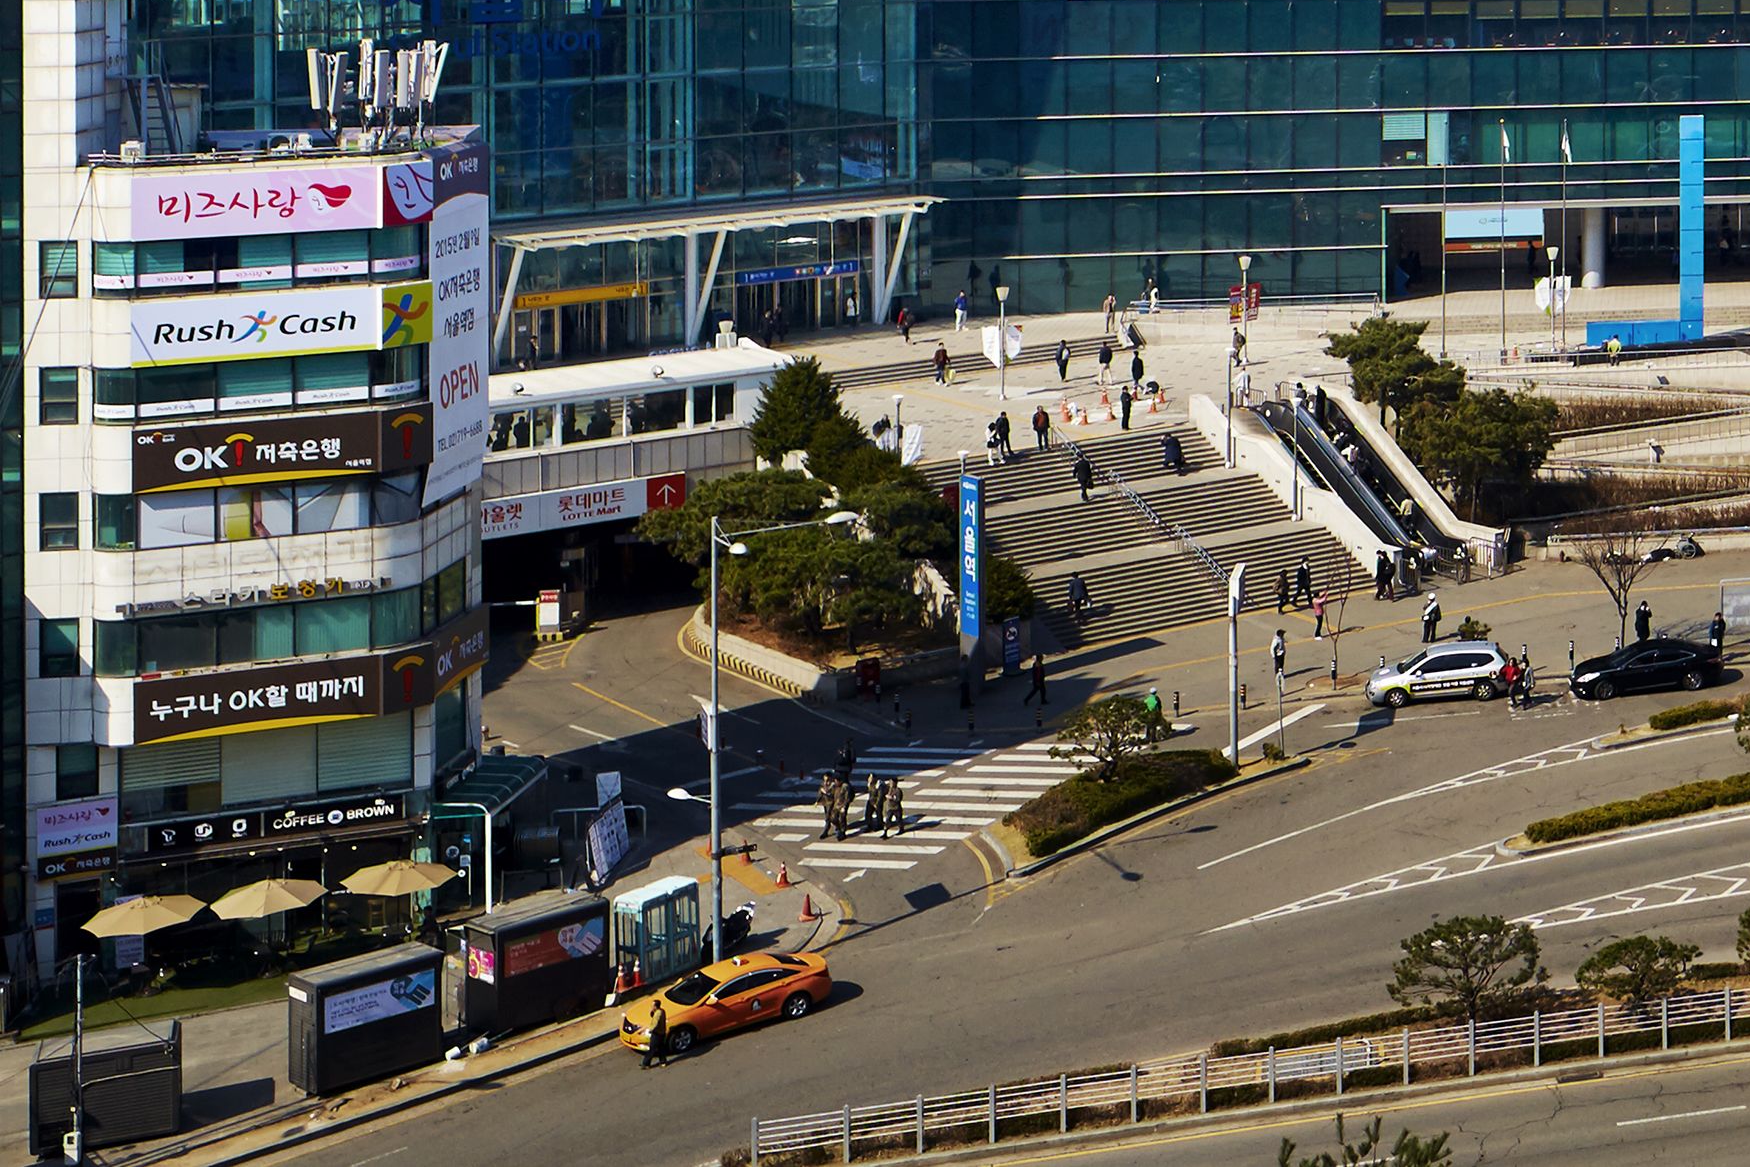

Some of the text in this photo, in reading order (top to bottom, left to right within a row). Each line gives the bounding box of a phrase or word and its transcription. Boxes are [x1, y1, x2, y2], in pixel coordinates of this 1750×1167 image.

[158, 186, 302, 223] 미즈사랑
[438, 268, 480, 301] OK저축은행
[154, 310, 357, 345] Rush Cash
[440, 360, 480, 409] OPEN
[255, 437, 341, 464] 저축은행
[557, 487, 626, 513] 롯데마트
[562, 504, 622, 522] LOTTE Mart
[963, 498, 976, 582] 서울역
[270, 576, 343, 601] 보청기
[437, 650, 453, 676] OK
[149, 675, 364, 722] 누구나 OK할 때까지
[272, 804, 395, 830] COFFEE BROWN
[44, 830, 111, 849] Rush Cash
[45, 862, 66, 875] OK
